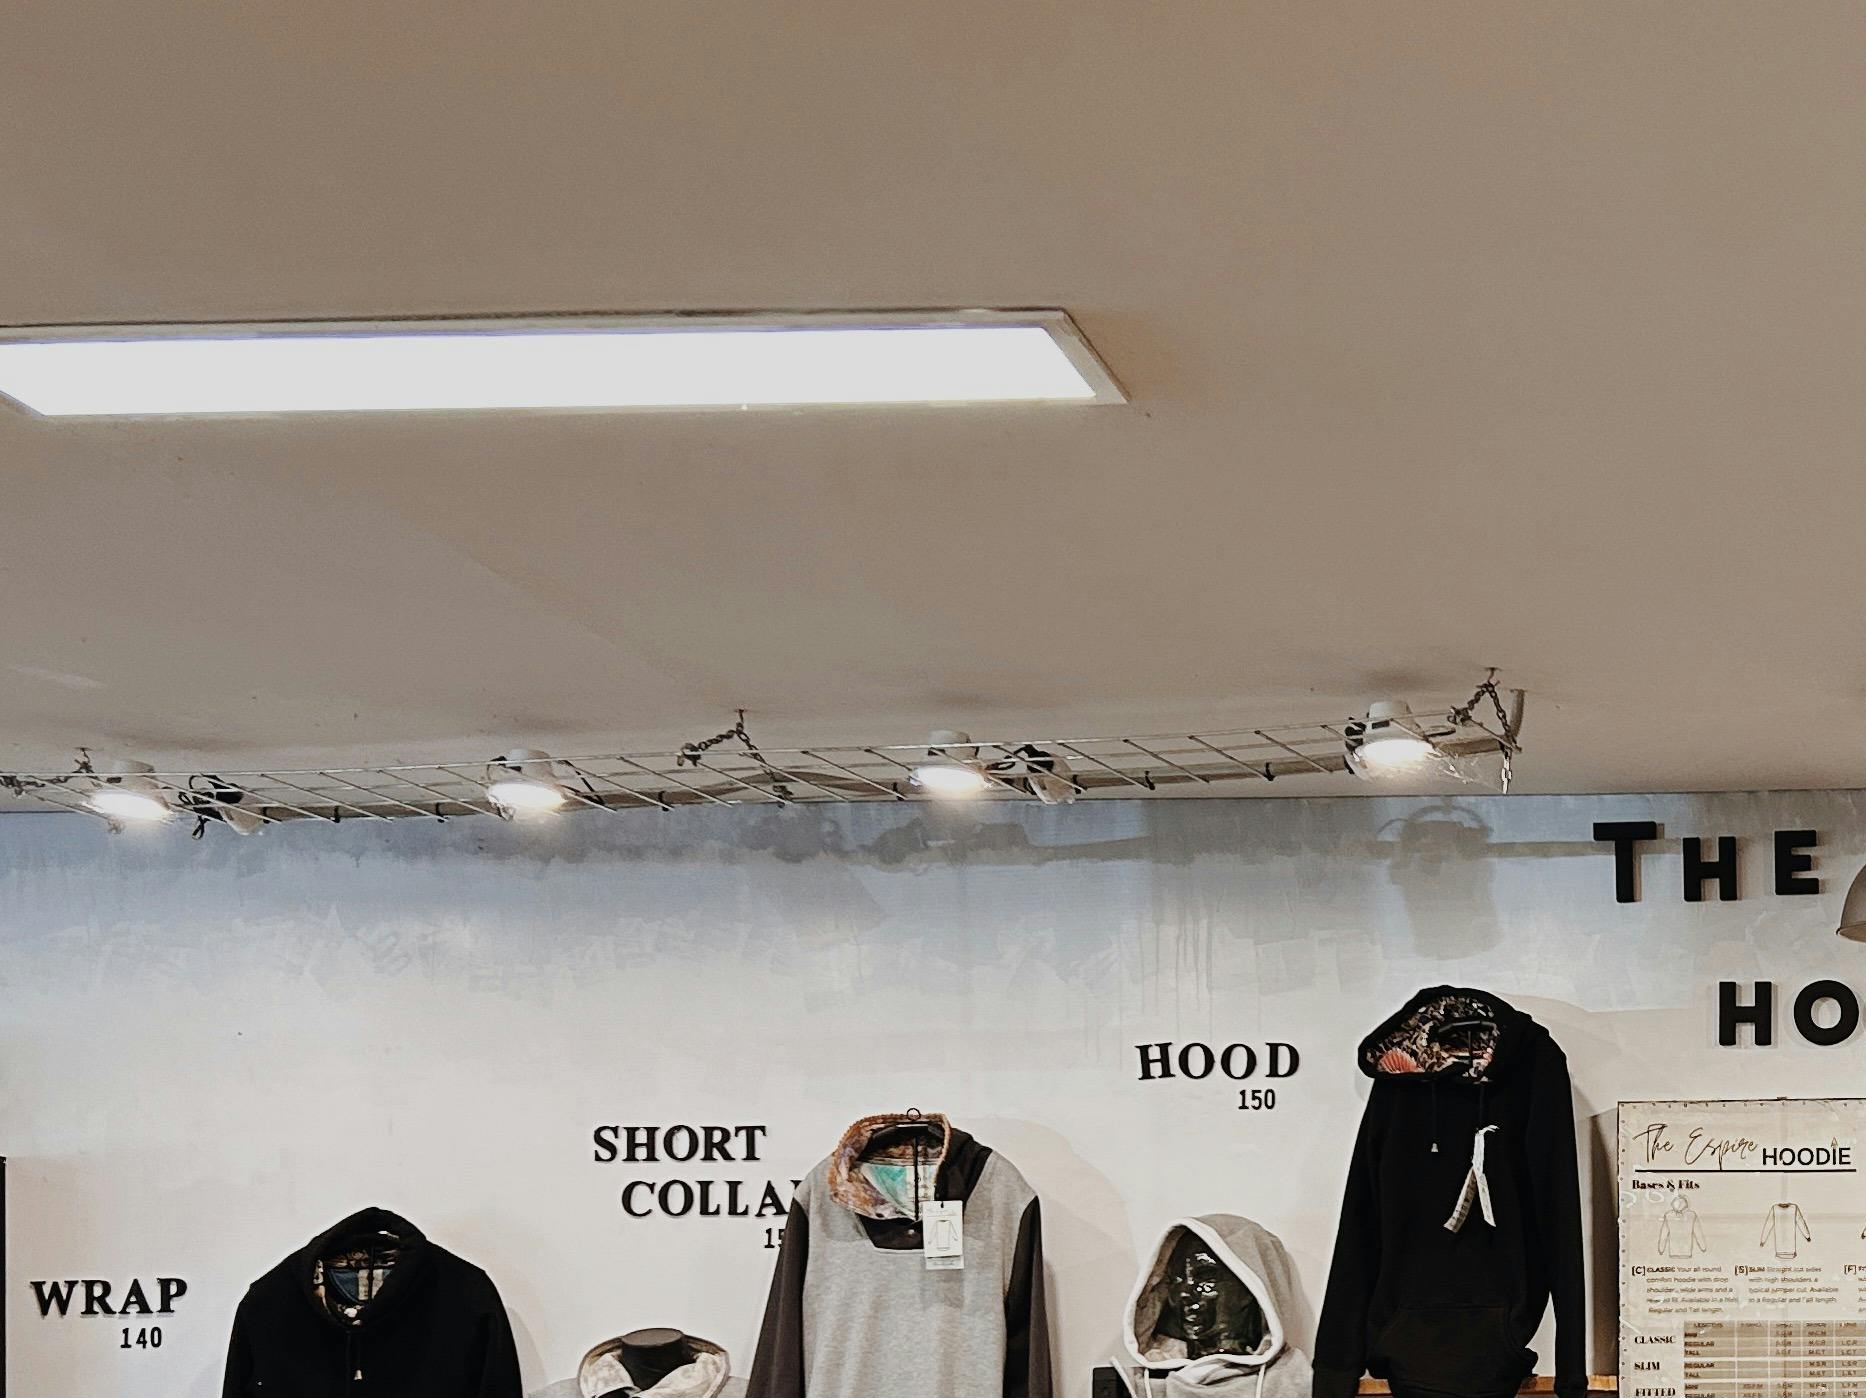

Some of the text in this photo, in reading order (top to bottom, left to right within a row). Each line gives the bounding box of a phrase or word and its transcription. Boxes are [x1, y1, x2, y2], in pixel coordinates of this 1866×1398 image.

[1593, 821, 1820, 903] THE
[1134, 1042, 1300, 1080] HOOD
[1238, 1088, 1276, 1110] 150
[593, 1124, 767, 1162] SHORT
[1633, 1123, 1674, 1163] The
[1762, 1147, 1851, 1166] HOODIE
[621, 1179, 802, 1218] COLLA
[30, 1278, 188, 1317] WRAP
[120, 1327, 163, 1349] 140
[1634, 1335, 1678, 1345] CLASSIC
[1635, 1387, 1676, 1397] FITTED
